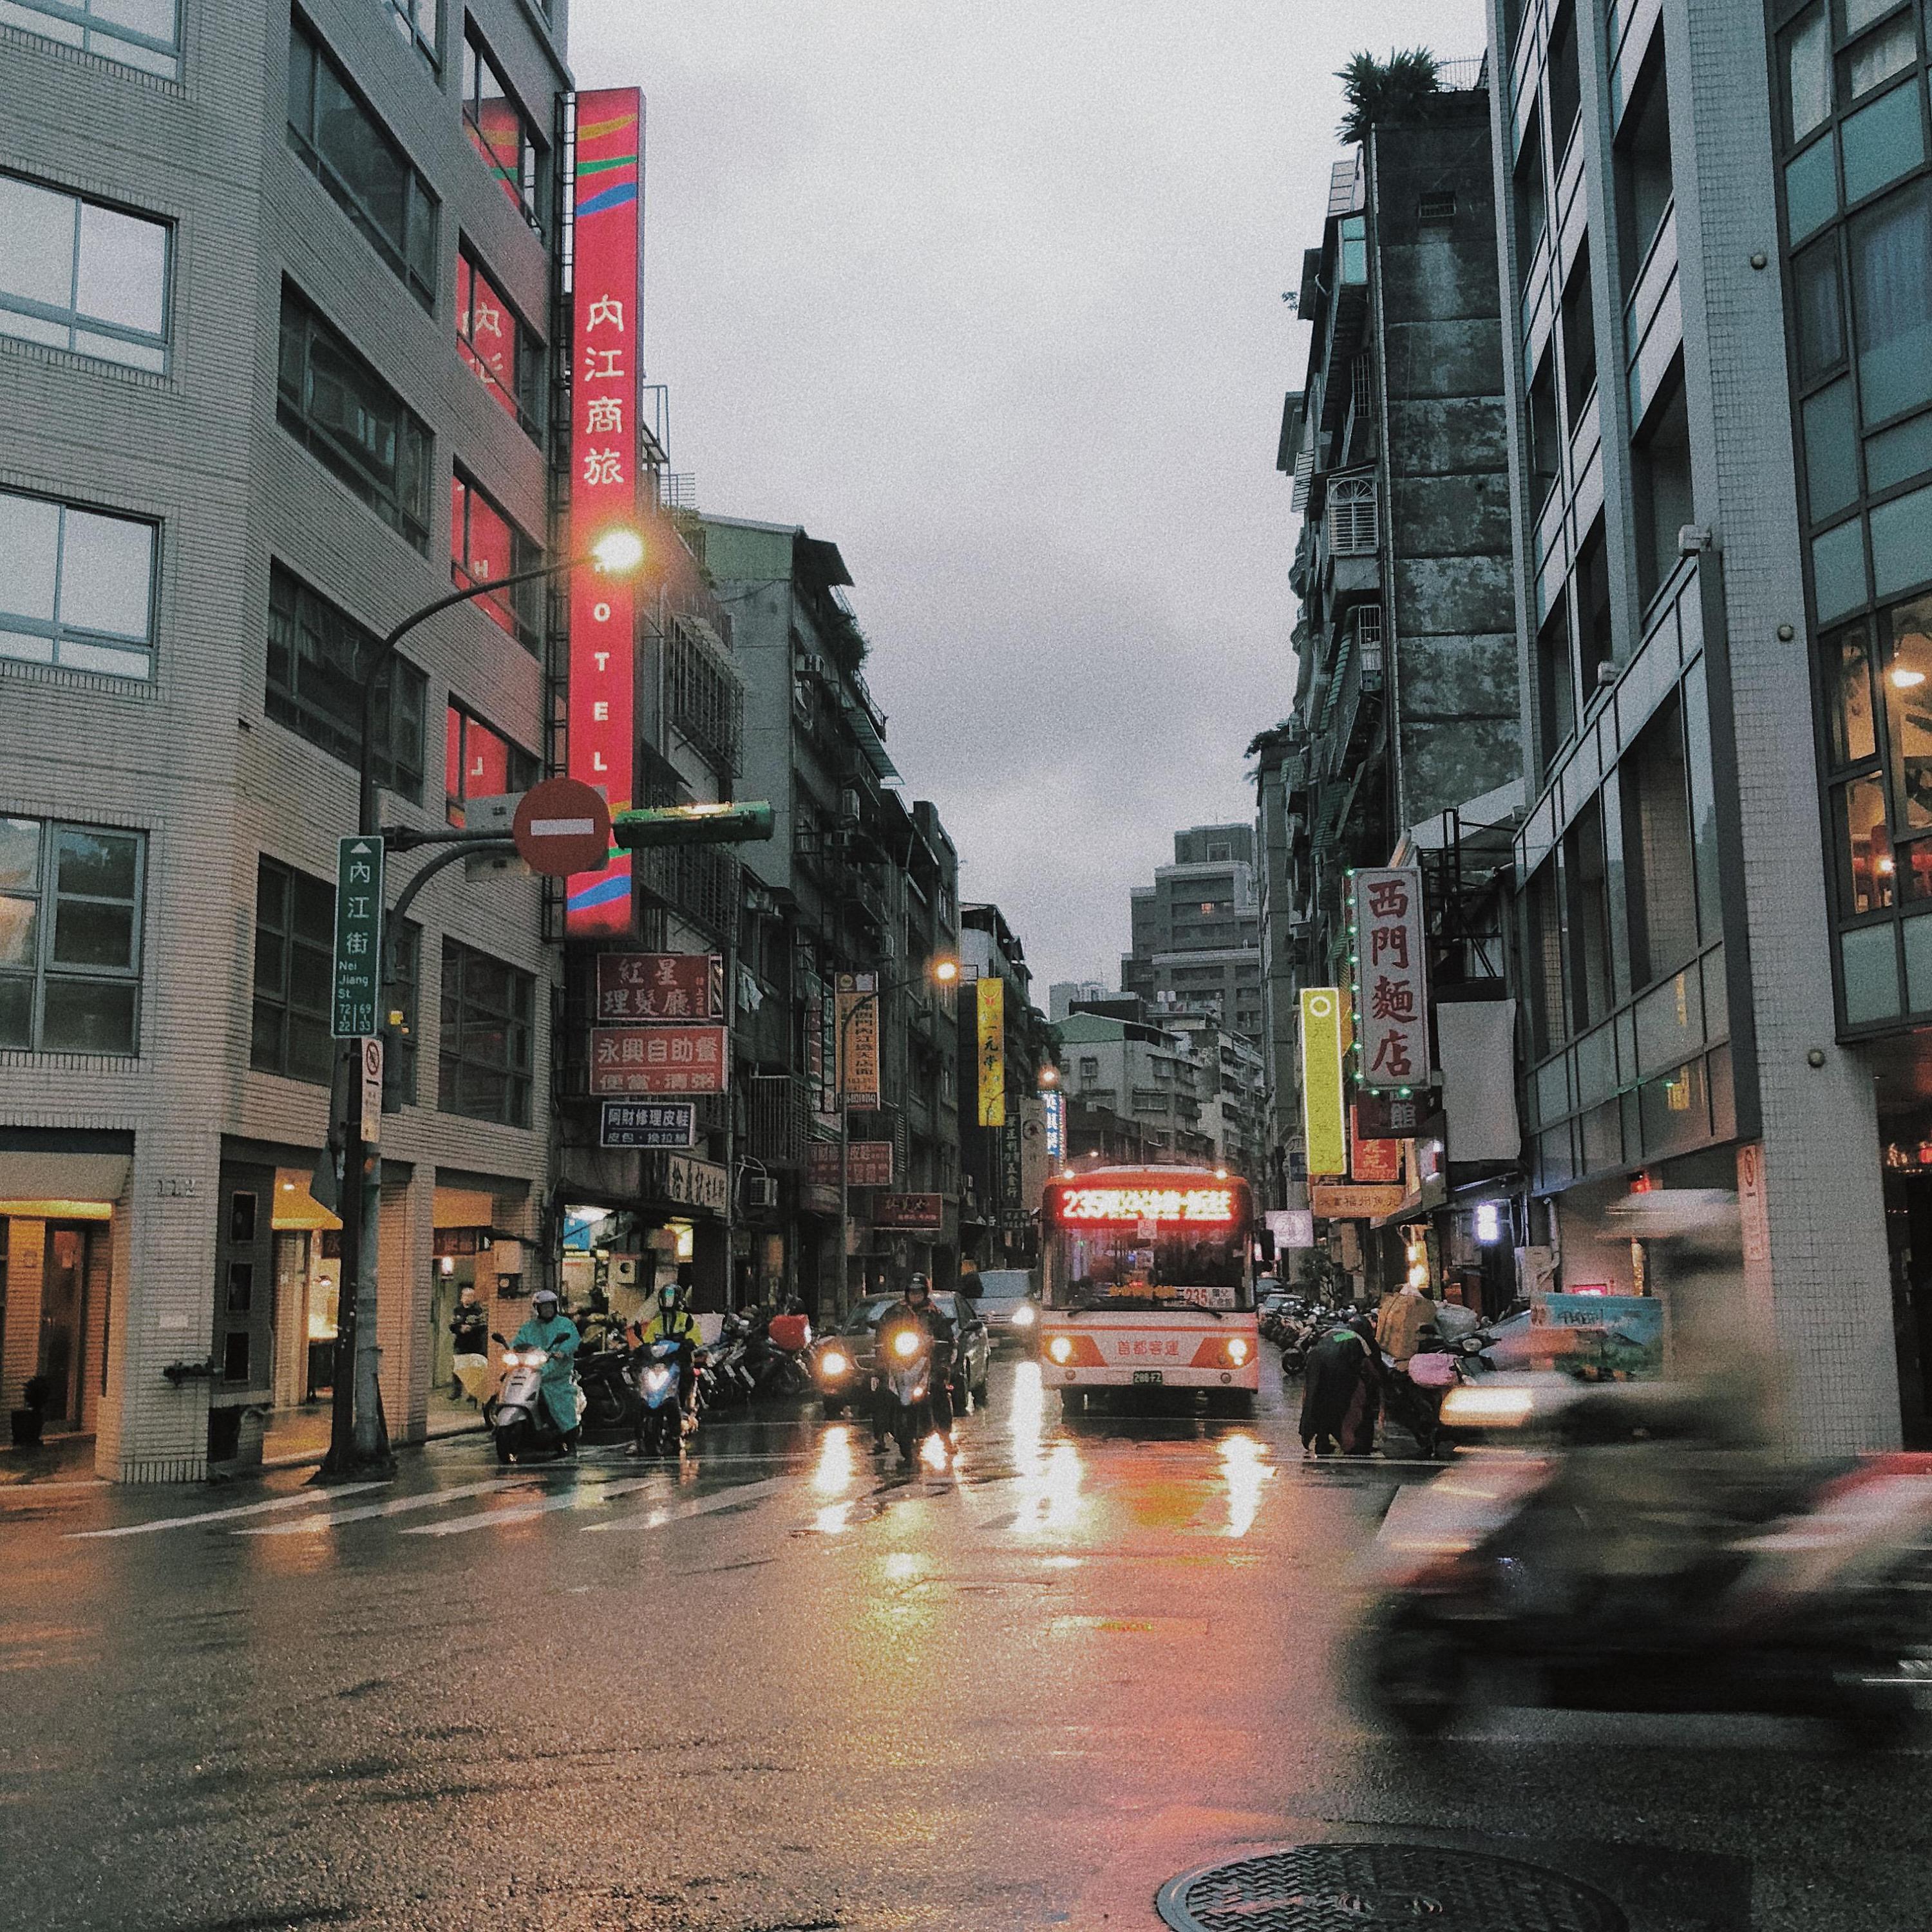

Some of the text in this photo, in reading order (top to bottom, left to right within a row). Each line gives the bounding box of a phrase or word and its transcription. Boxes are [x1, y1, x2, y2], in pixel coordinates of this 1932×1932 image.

[346, 861, 372, 954] 內江街
[339, 960, 357, 971] Nei
[618, 958, 678, 986] 紅星
[338, 974, 369, 987] Jiang
[1367, 878, 1418, 1078] 西門麵店
[339, 1003, 372, 1014] 72 69
[604, 988, 692, 1016] 理髮廳
[338, 1021, 371, 1032] 22 33
[597, 1036, 718, 1064] 永興自助餐
[608, 1108, 689, 1127] 阿財修理皮鞋
[1186, 1288, 1208, 1305] 235
[1117, 1340, 1180, 1356] 首都客運
